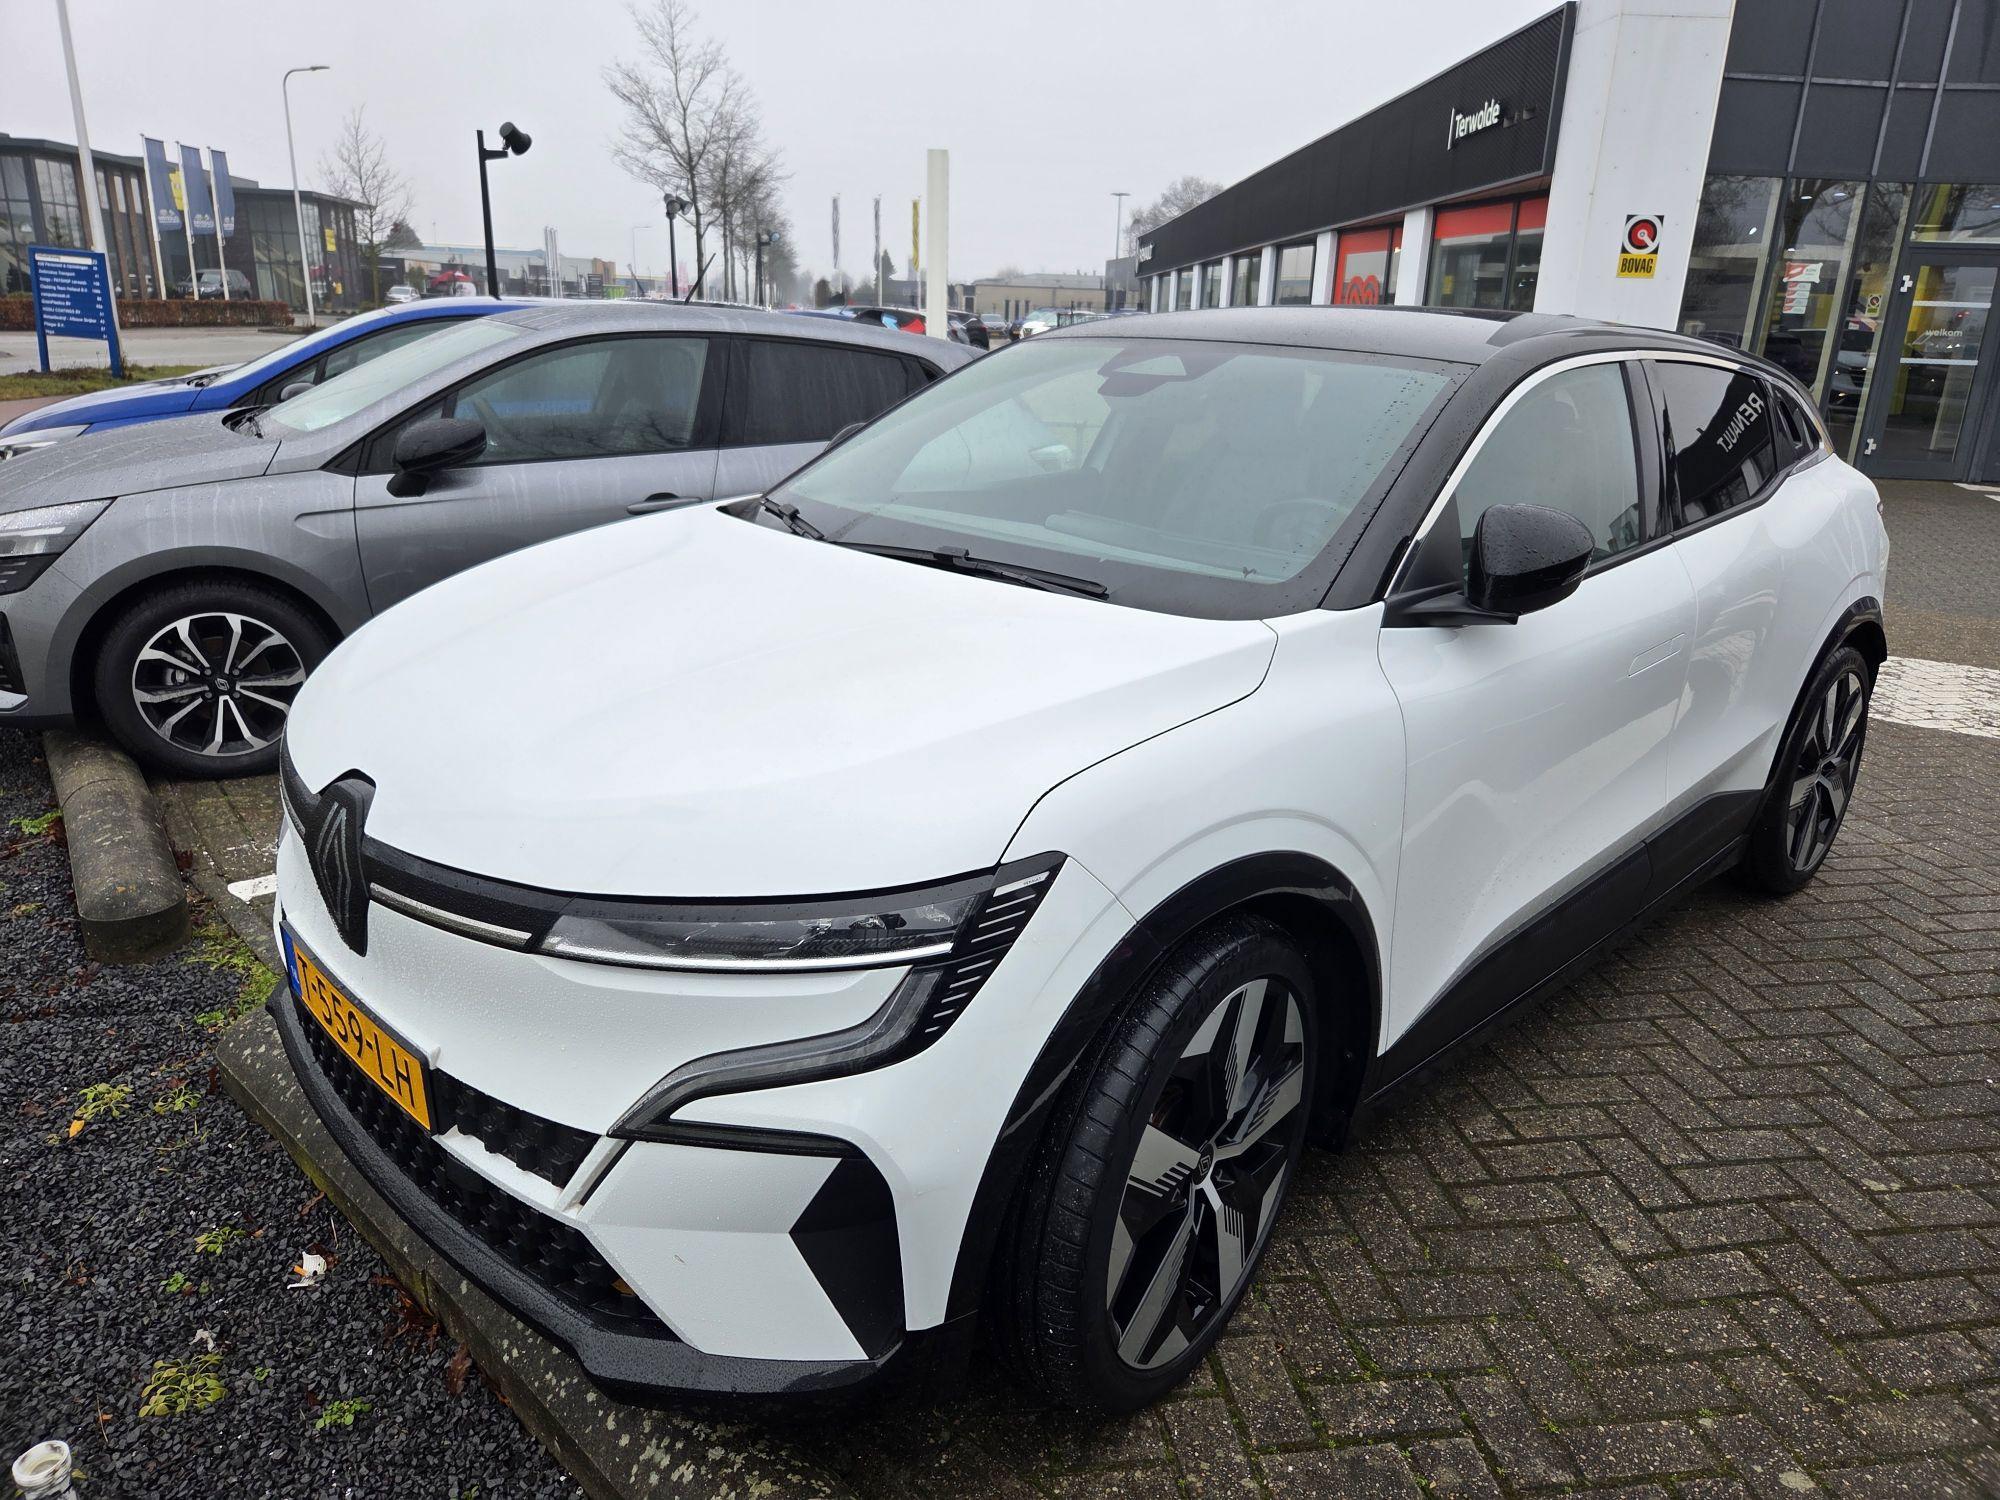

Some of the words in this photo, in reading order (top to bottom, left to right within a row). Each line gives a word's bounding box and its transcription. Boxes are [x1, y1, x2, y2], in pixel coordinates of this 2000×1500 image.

[1455, 98, 1500, 139] Terwolde
[1620, 258, 1653, 273] BOVAG
[1925, 329, 1963, 337] welkom
[297, 955, 416, 1109] T-559-LH
